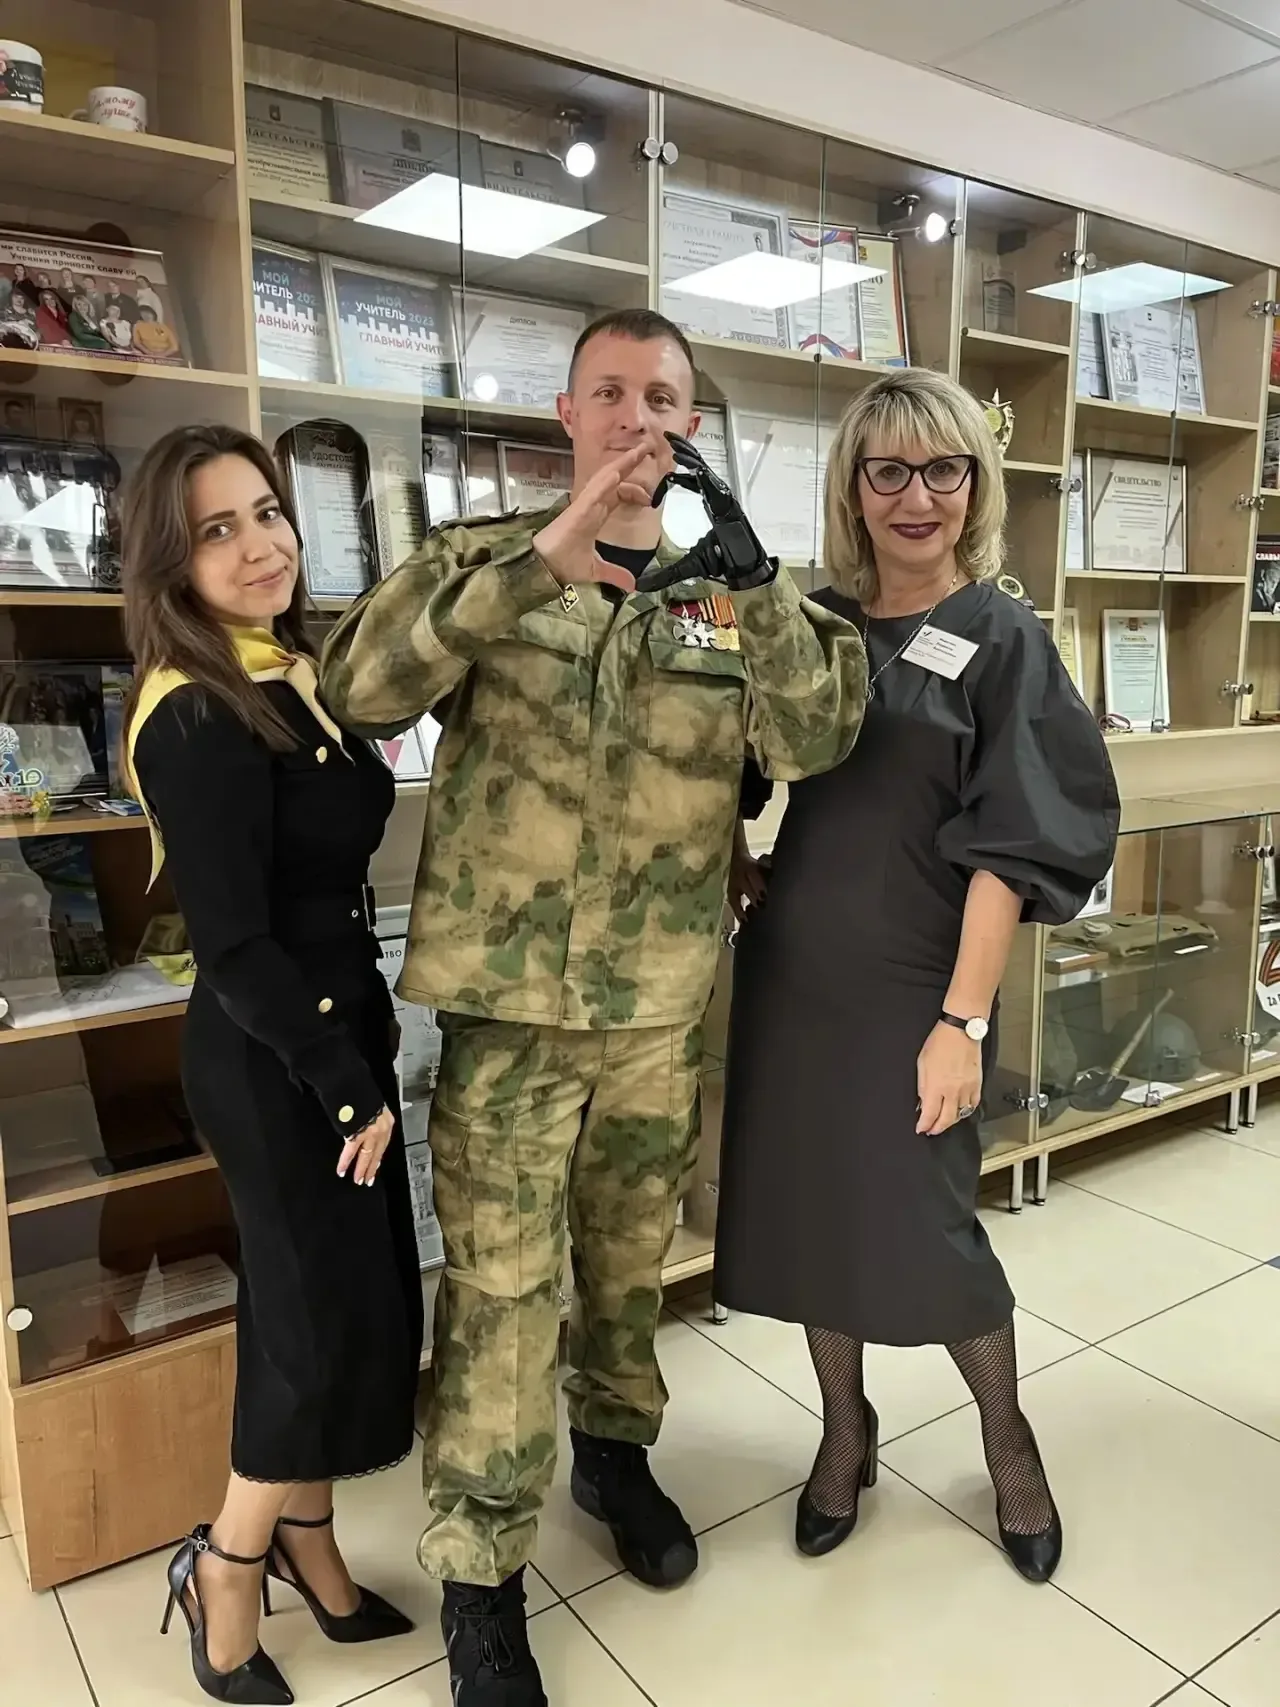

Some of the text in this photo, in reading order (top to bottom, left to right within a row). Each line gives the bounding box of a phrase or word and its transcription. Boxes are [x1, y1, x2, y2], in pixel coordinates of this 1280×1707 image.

[16, 245, 58, 257] славится
[60, 250, 95, 263] Россия,
[10, 252, 50, 265] Ученики
[52, 259, 96, 271] приносят
[97, 266, 124, 275] славу
[262, 270, 290, 287] МОЙ
[355, 301, 434, 327] УЧИТЕЛЬ 2023
[360, 332, 412, 350] ГЛАВНЫЙ
